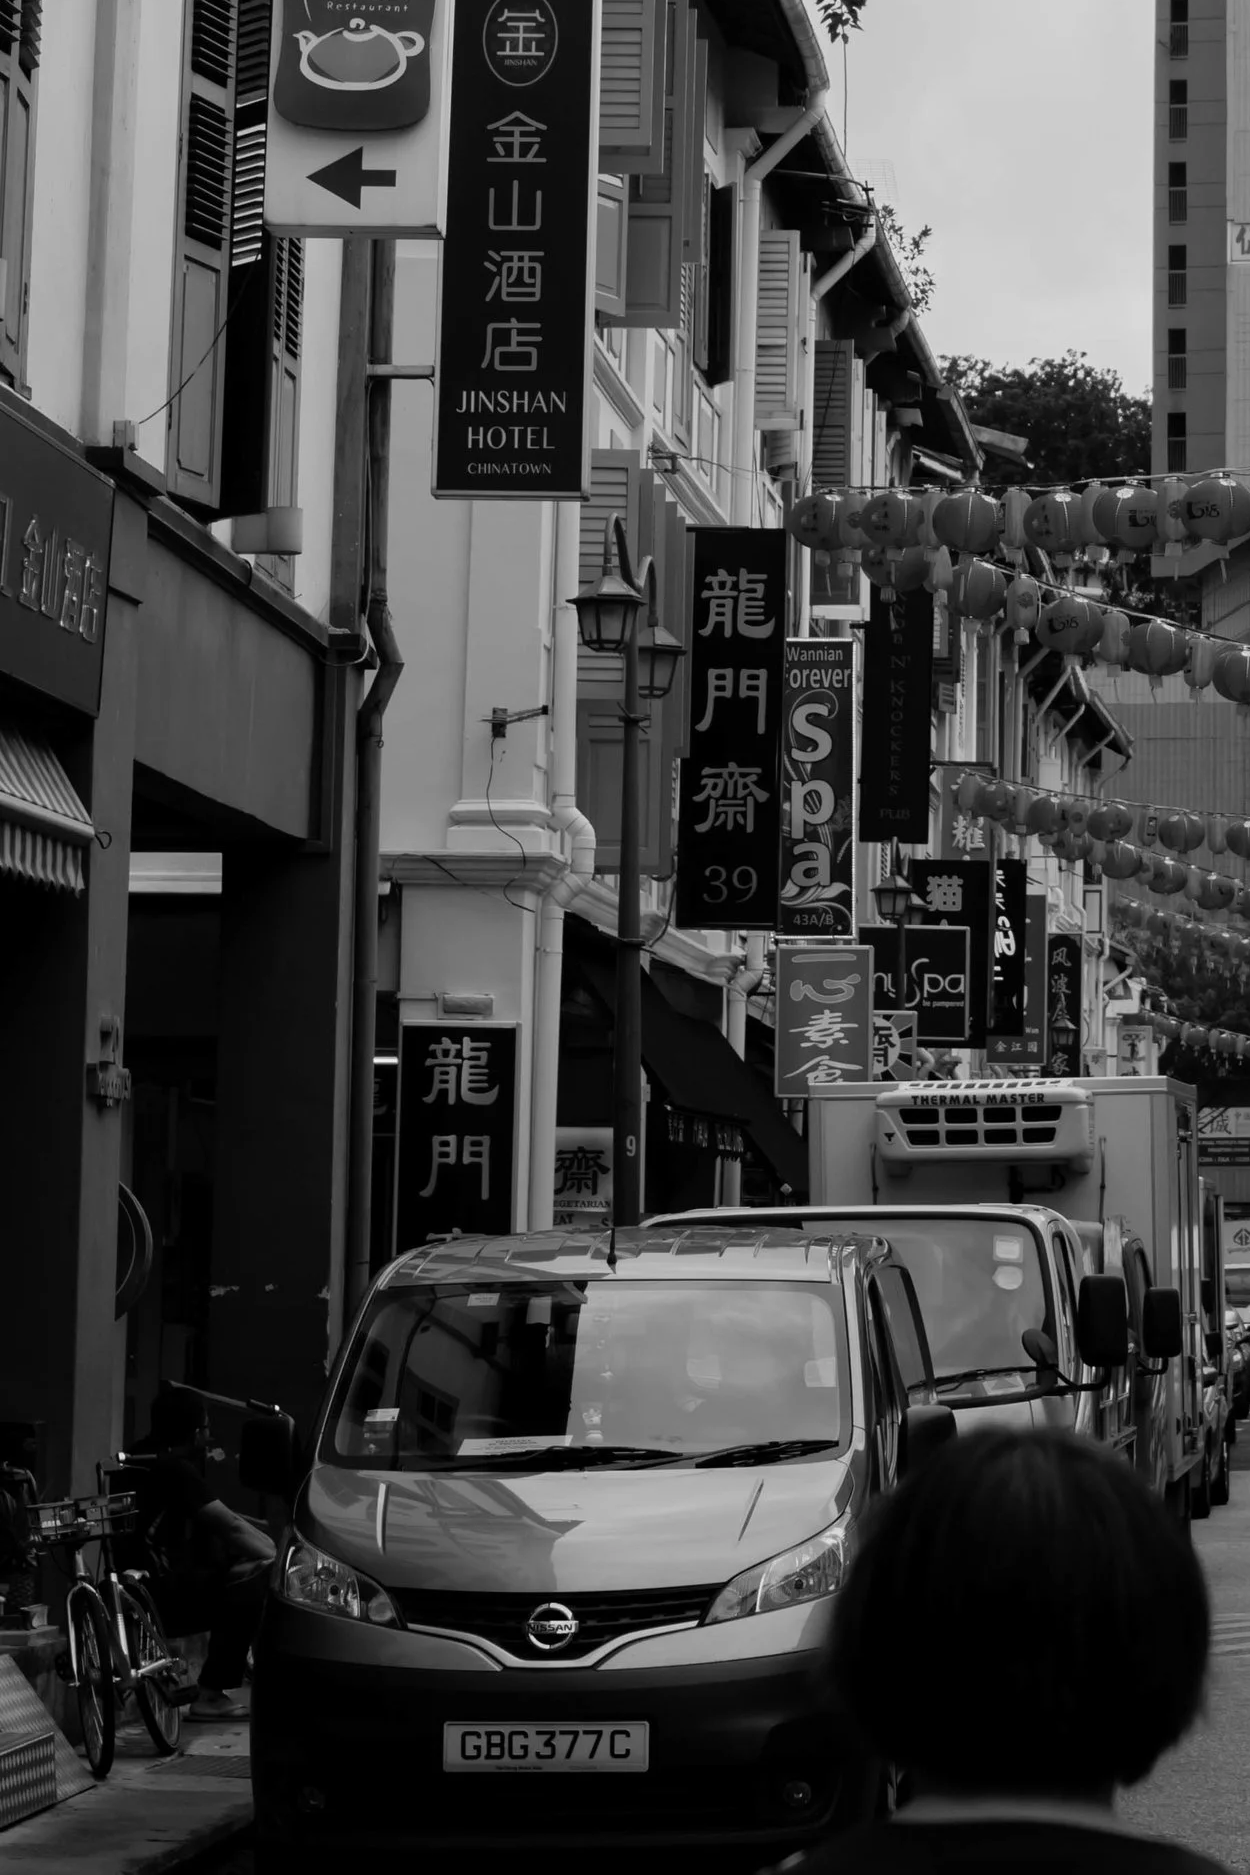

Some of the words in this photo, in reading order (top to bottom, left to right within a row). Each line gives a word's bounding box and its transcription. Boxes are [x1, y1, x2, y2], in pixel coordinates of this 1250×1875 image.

[327, 2, 409, 13] Restaurant
[503, 59, 538, 67] JINSHAN
[481, 110, 547, 372] 金山酒店
[456, 390, 567, 414] JINSHAN
[467, 426, 555, 450] HOTEL
[467, 463, 552, 476] CHINATOWN
[786, 646, 844, 662] Wannian
[786, 667, 851, 688] orever
[692, 567, 776, 834] 龍門齋
[889, 679, 906, 797] KNOCKERS
[791, 702, 836, 888] Spa
[879, 807, 911, 820] PUB
[703, 865, 758, 905] 39
[793, 912, 834, 928] 43A/B
[911, 1094, 981, 1106] THERMAL
[985, 1092, 1046, 1105] MASTER
[418, 1036, 500, 1241] 龍門
[625, 1135, 637, 1157] 9
[554, 1199, 612, 1208] EGETARIAN
[529, 1624, 573, 1632] NISSAN
[461, 1729, 631, 1760] GBG377C
